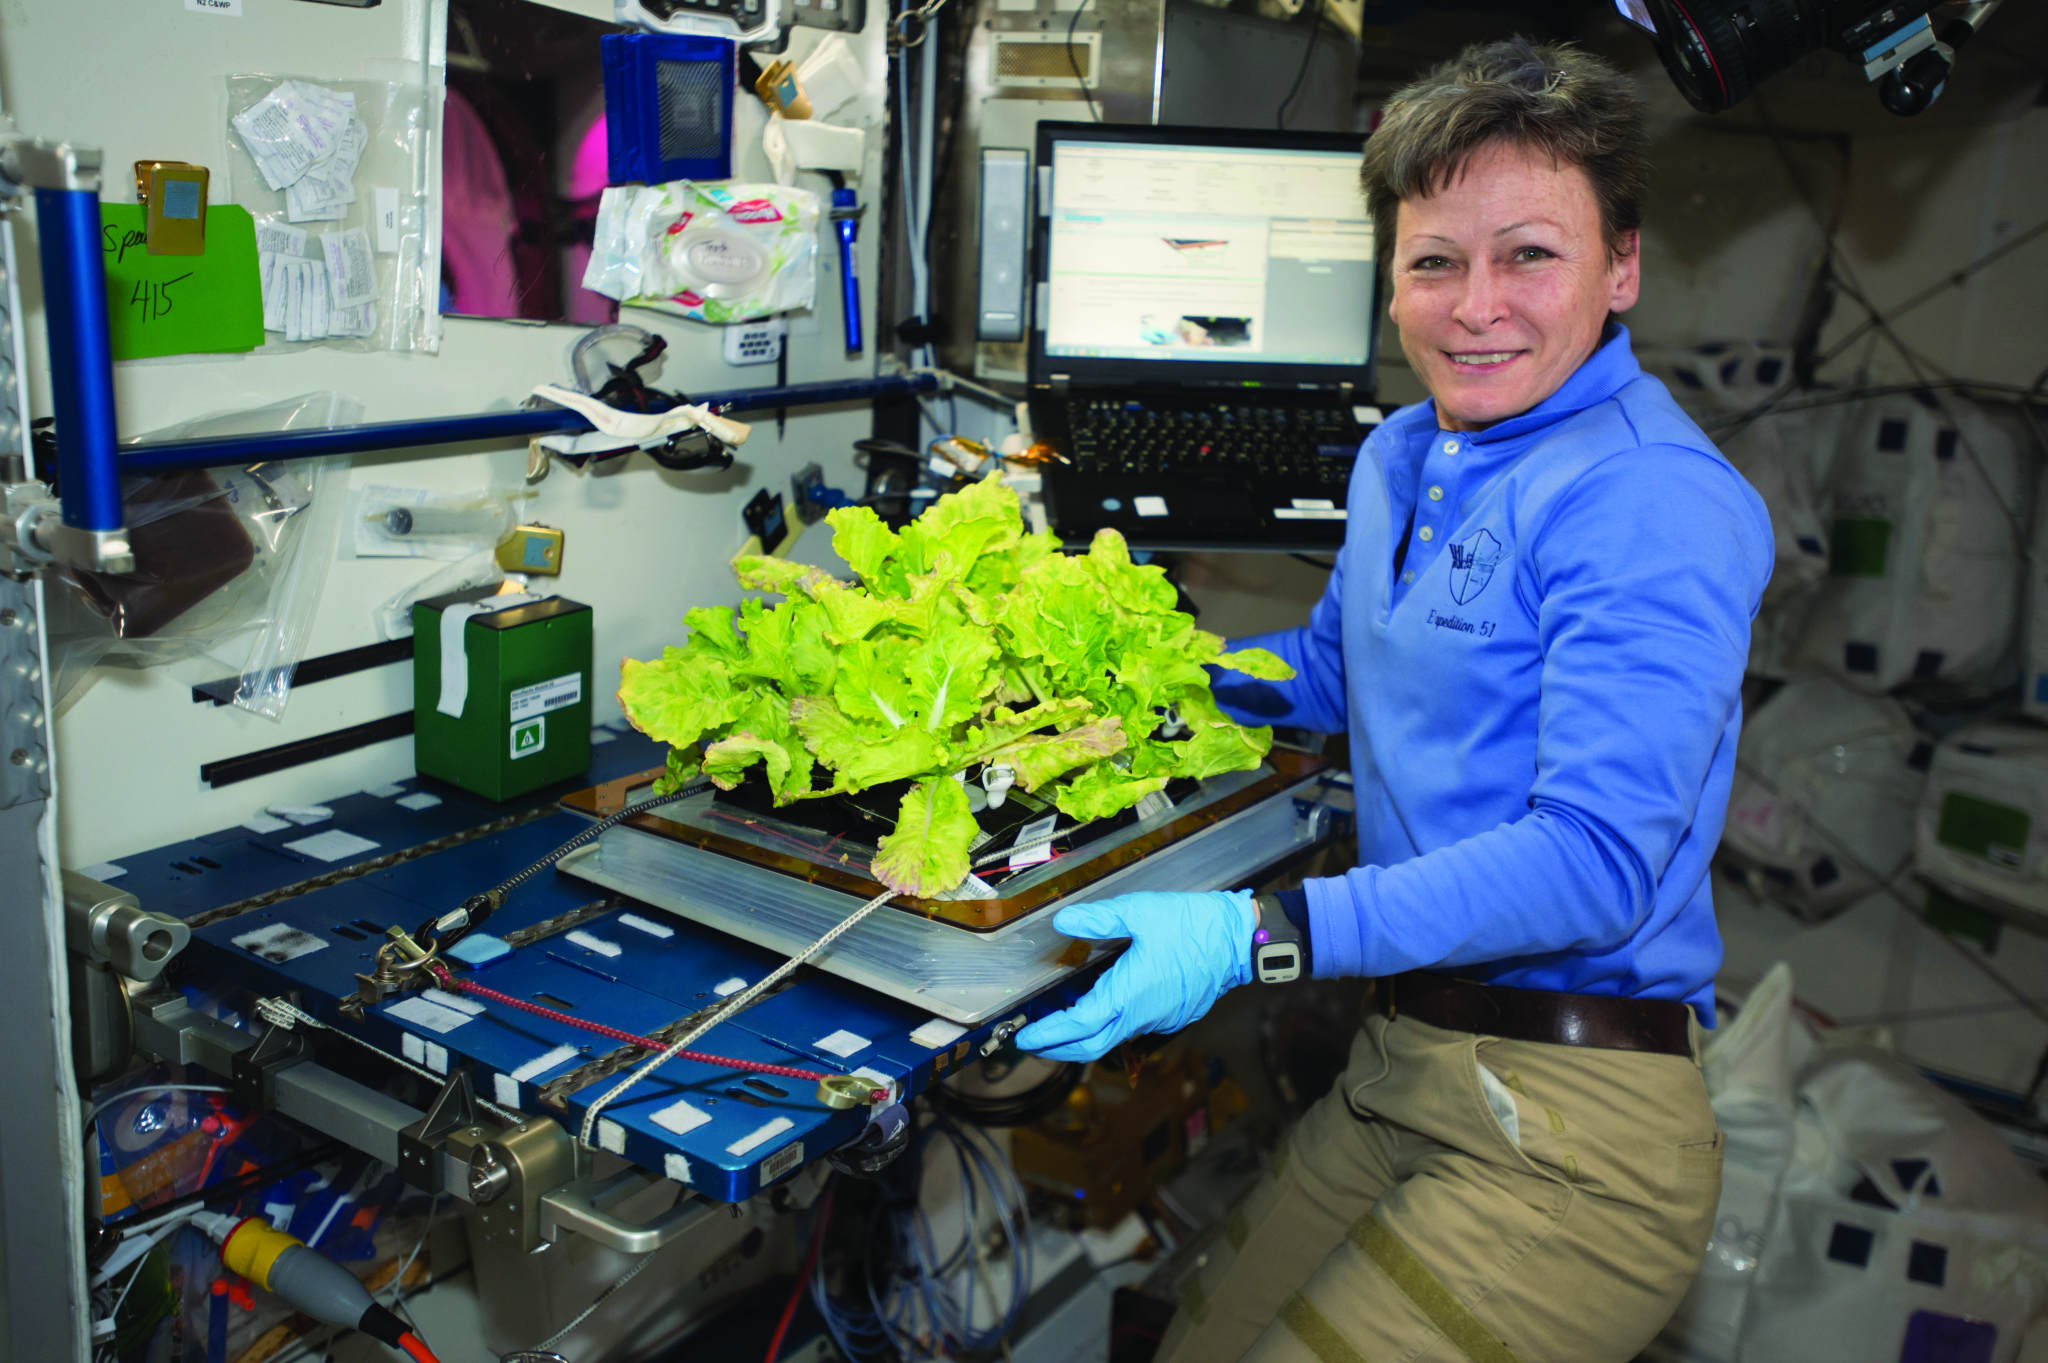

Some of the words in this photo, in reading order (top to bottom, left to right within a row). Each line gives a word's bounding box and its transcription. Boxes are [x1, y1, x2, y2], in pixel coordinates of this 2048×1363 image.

[208, 0, 231, 9] C&WP
[130, 271, 194, 324] 415
[1426, 609, 1475, 634] Expedition
[1480, 621, 1496, 638] 51
